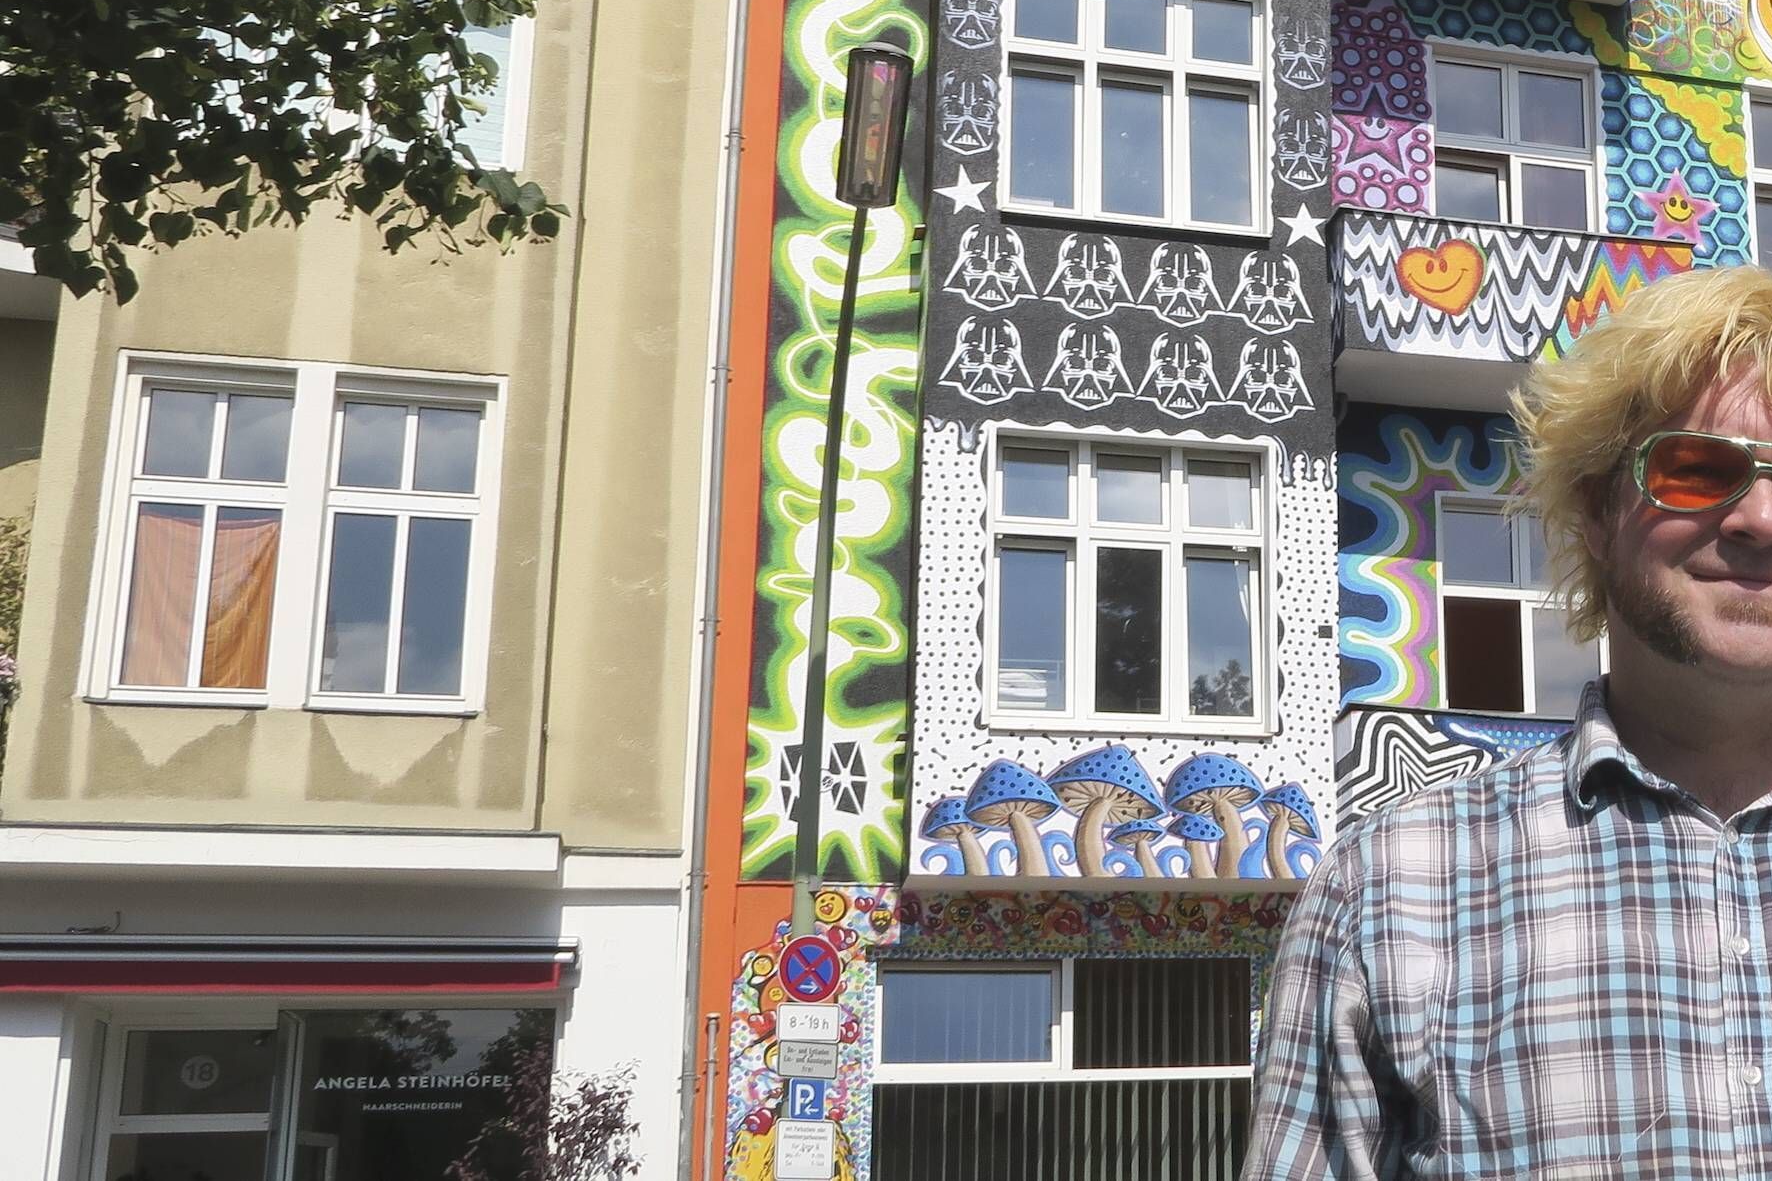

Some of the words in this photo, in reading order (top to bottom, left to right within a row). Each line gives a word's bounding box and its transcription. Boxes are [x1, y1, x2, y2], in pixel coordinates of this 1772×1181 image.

[185, 1062, 214, 1081] 18
[313, 1075, 391, 1091] ANGELA
[397, 1071, 513, 1089] STEINHÖFEL
[362, 1101, 463, 1111] HAARSCHNEIDERIN
